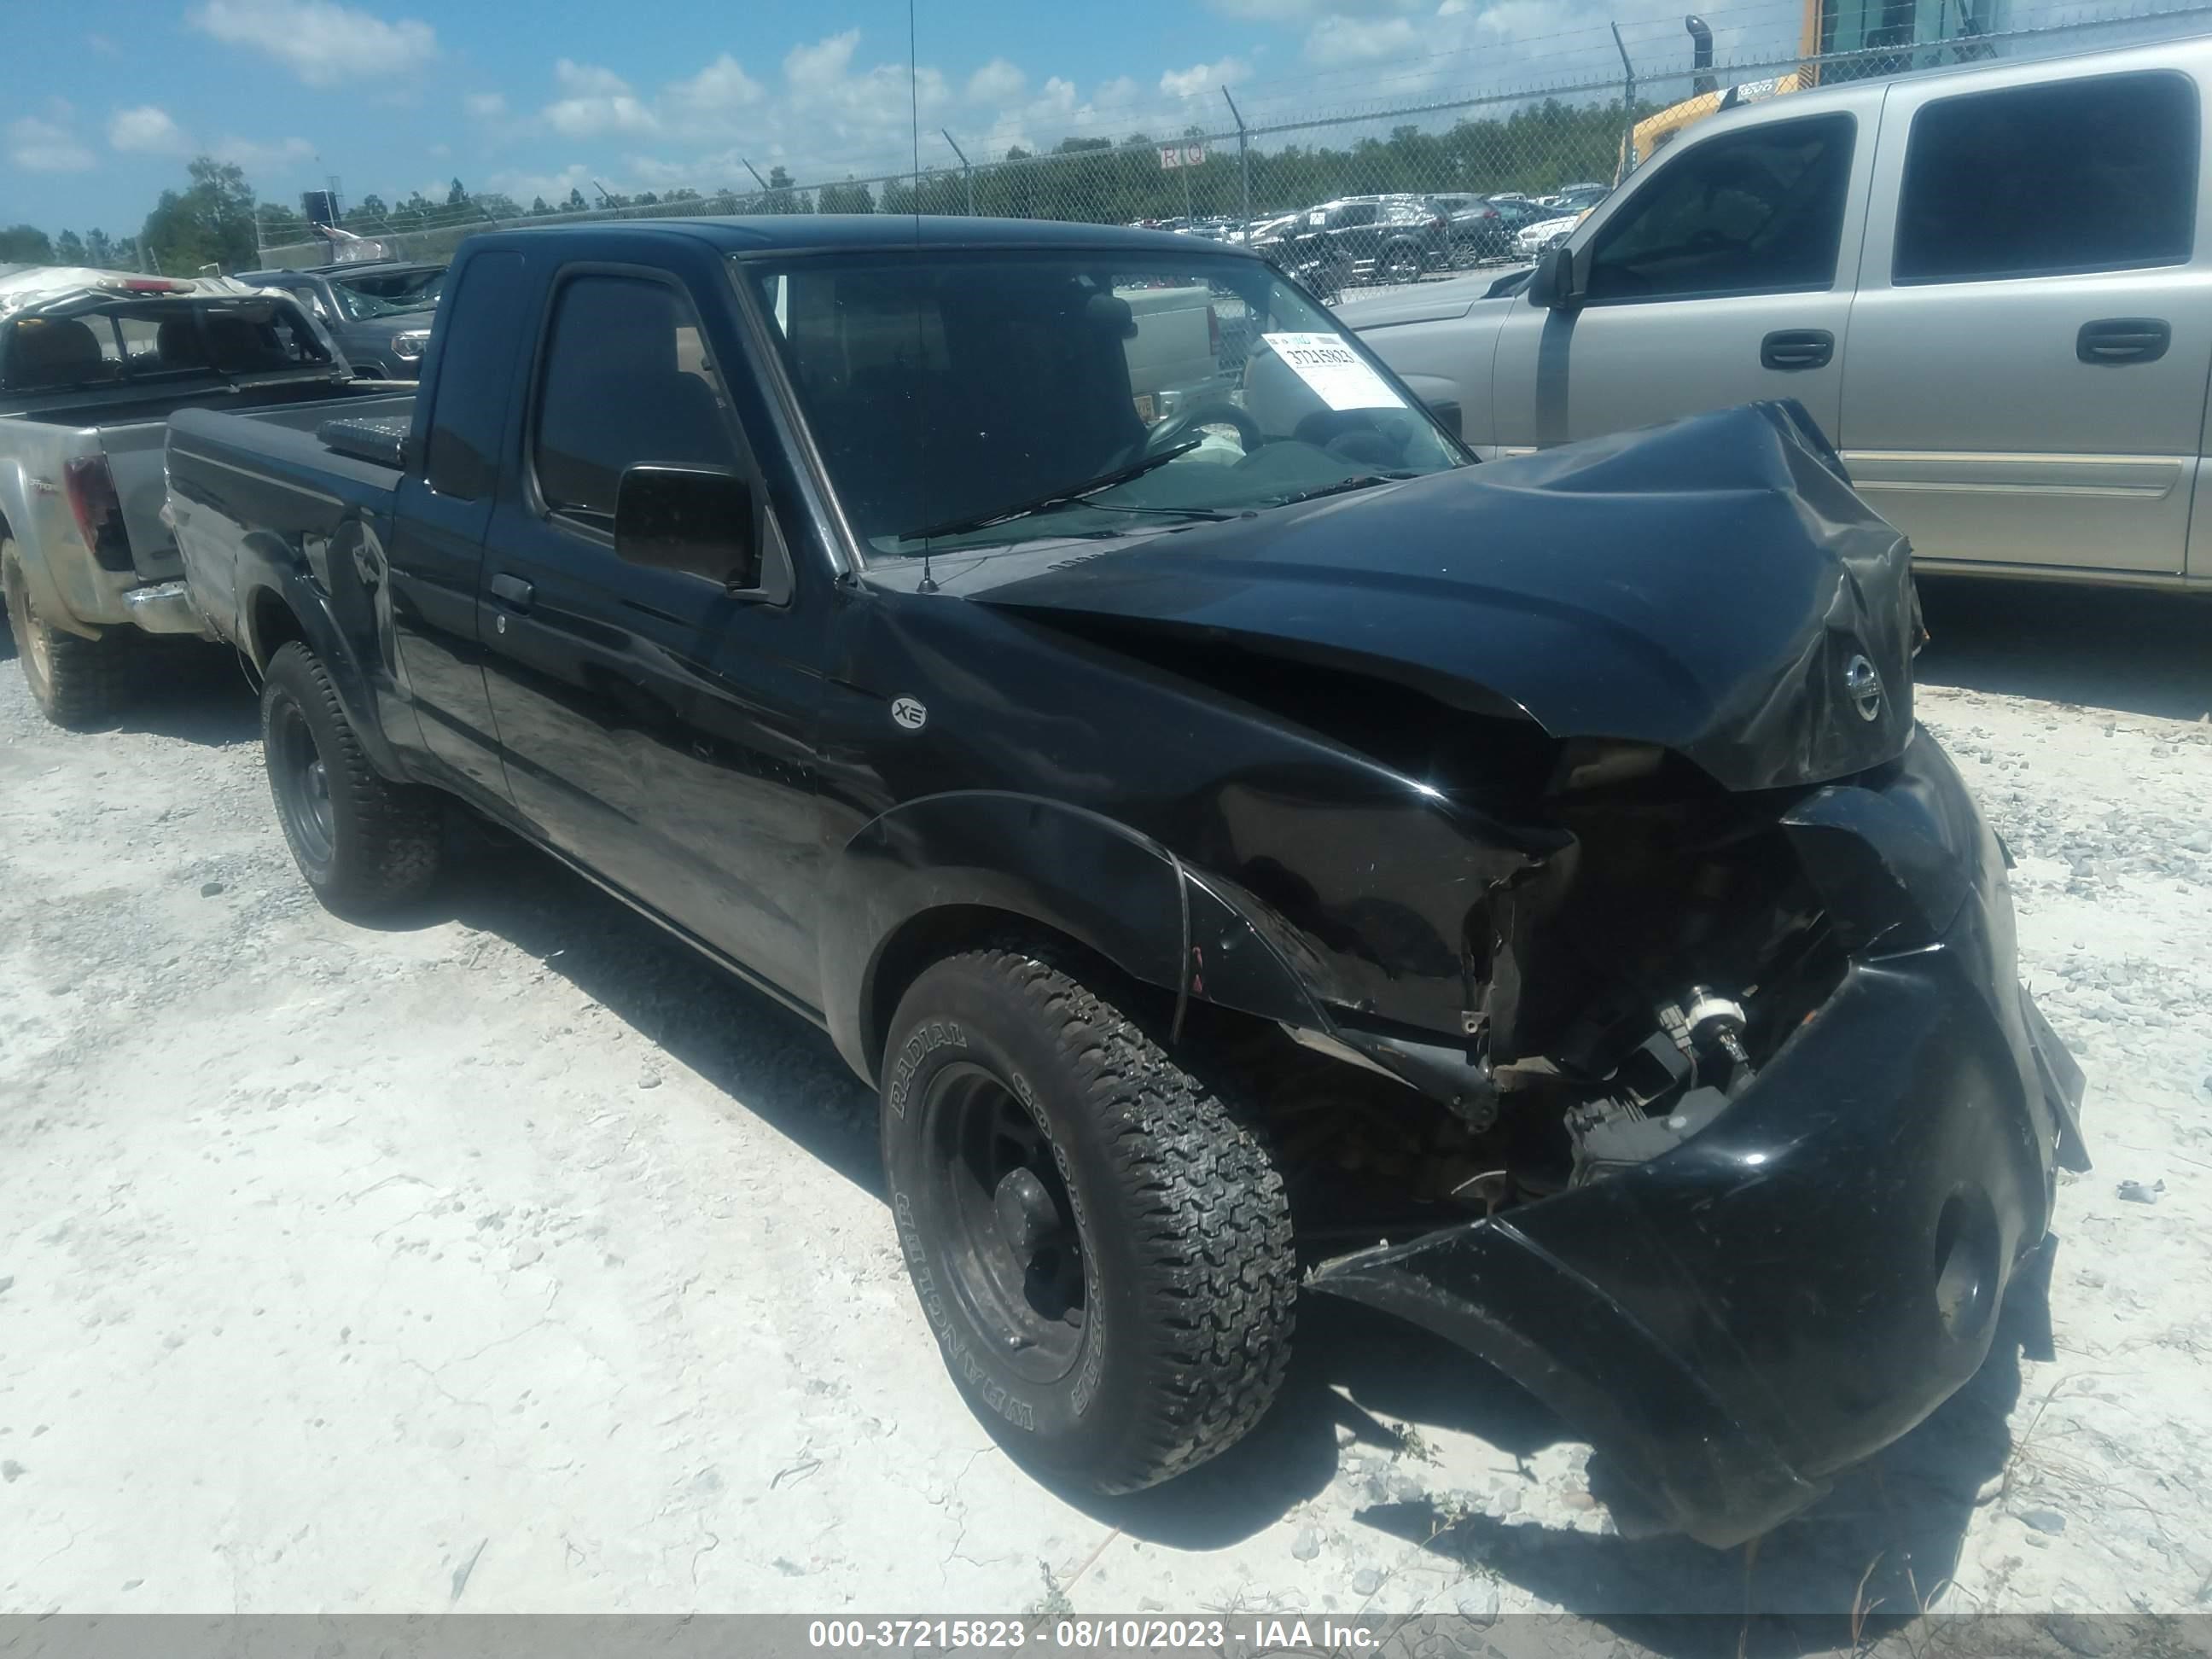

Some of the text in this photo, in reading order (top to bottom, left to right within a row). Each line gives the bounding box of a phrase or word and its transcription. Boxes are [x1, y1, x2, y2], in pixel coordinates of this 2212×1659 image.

[1163, 146, 1177, 167] R
[1286, 349, 1355, 365] 37215823
[894, 701, 923, 725] XE
[890, 1022, 968, 1120] RADIAL
[1012, 1072, 1103, 1417] GOODYEAR
[896, 1192, 1034, 1431] WRANGLER
